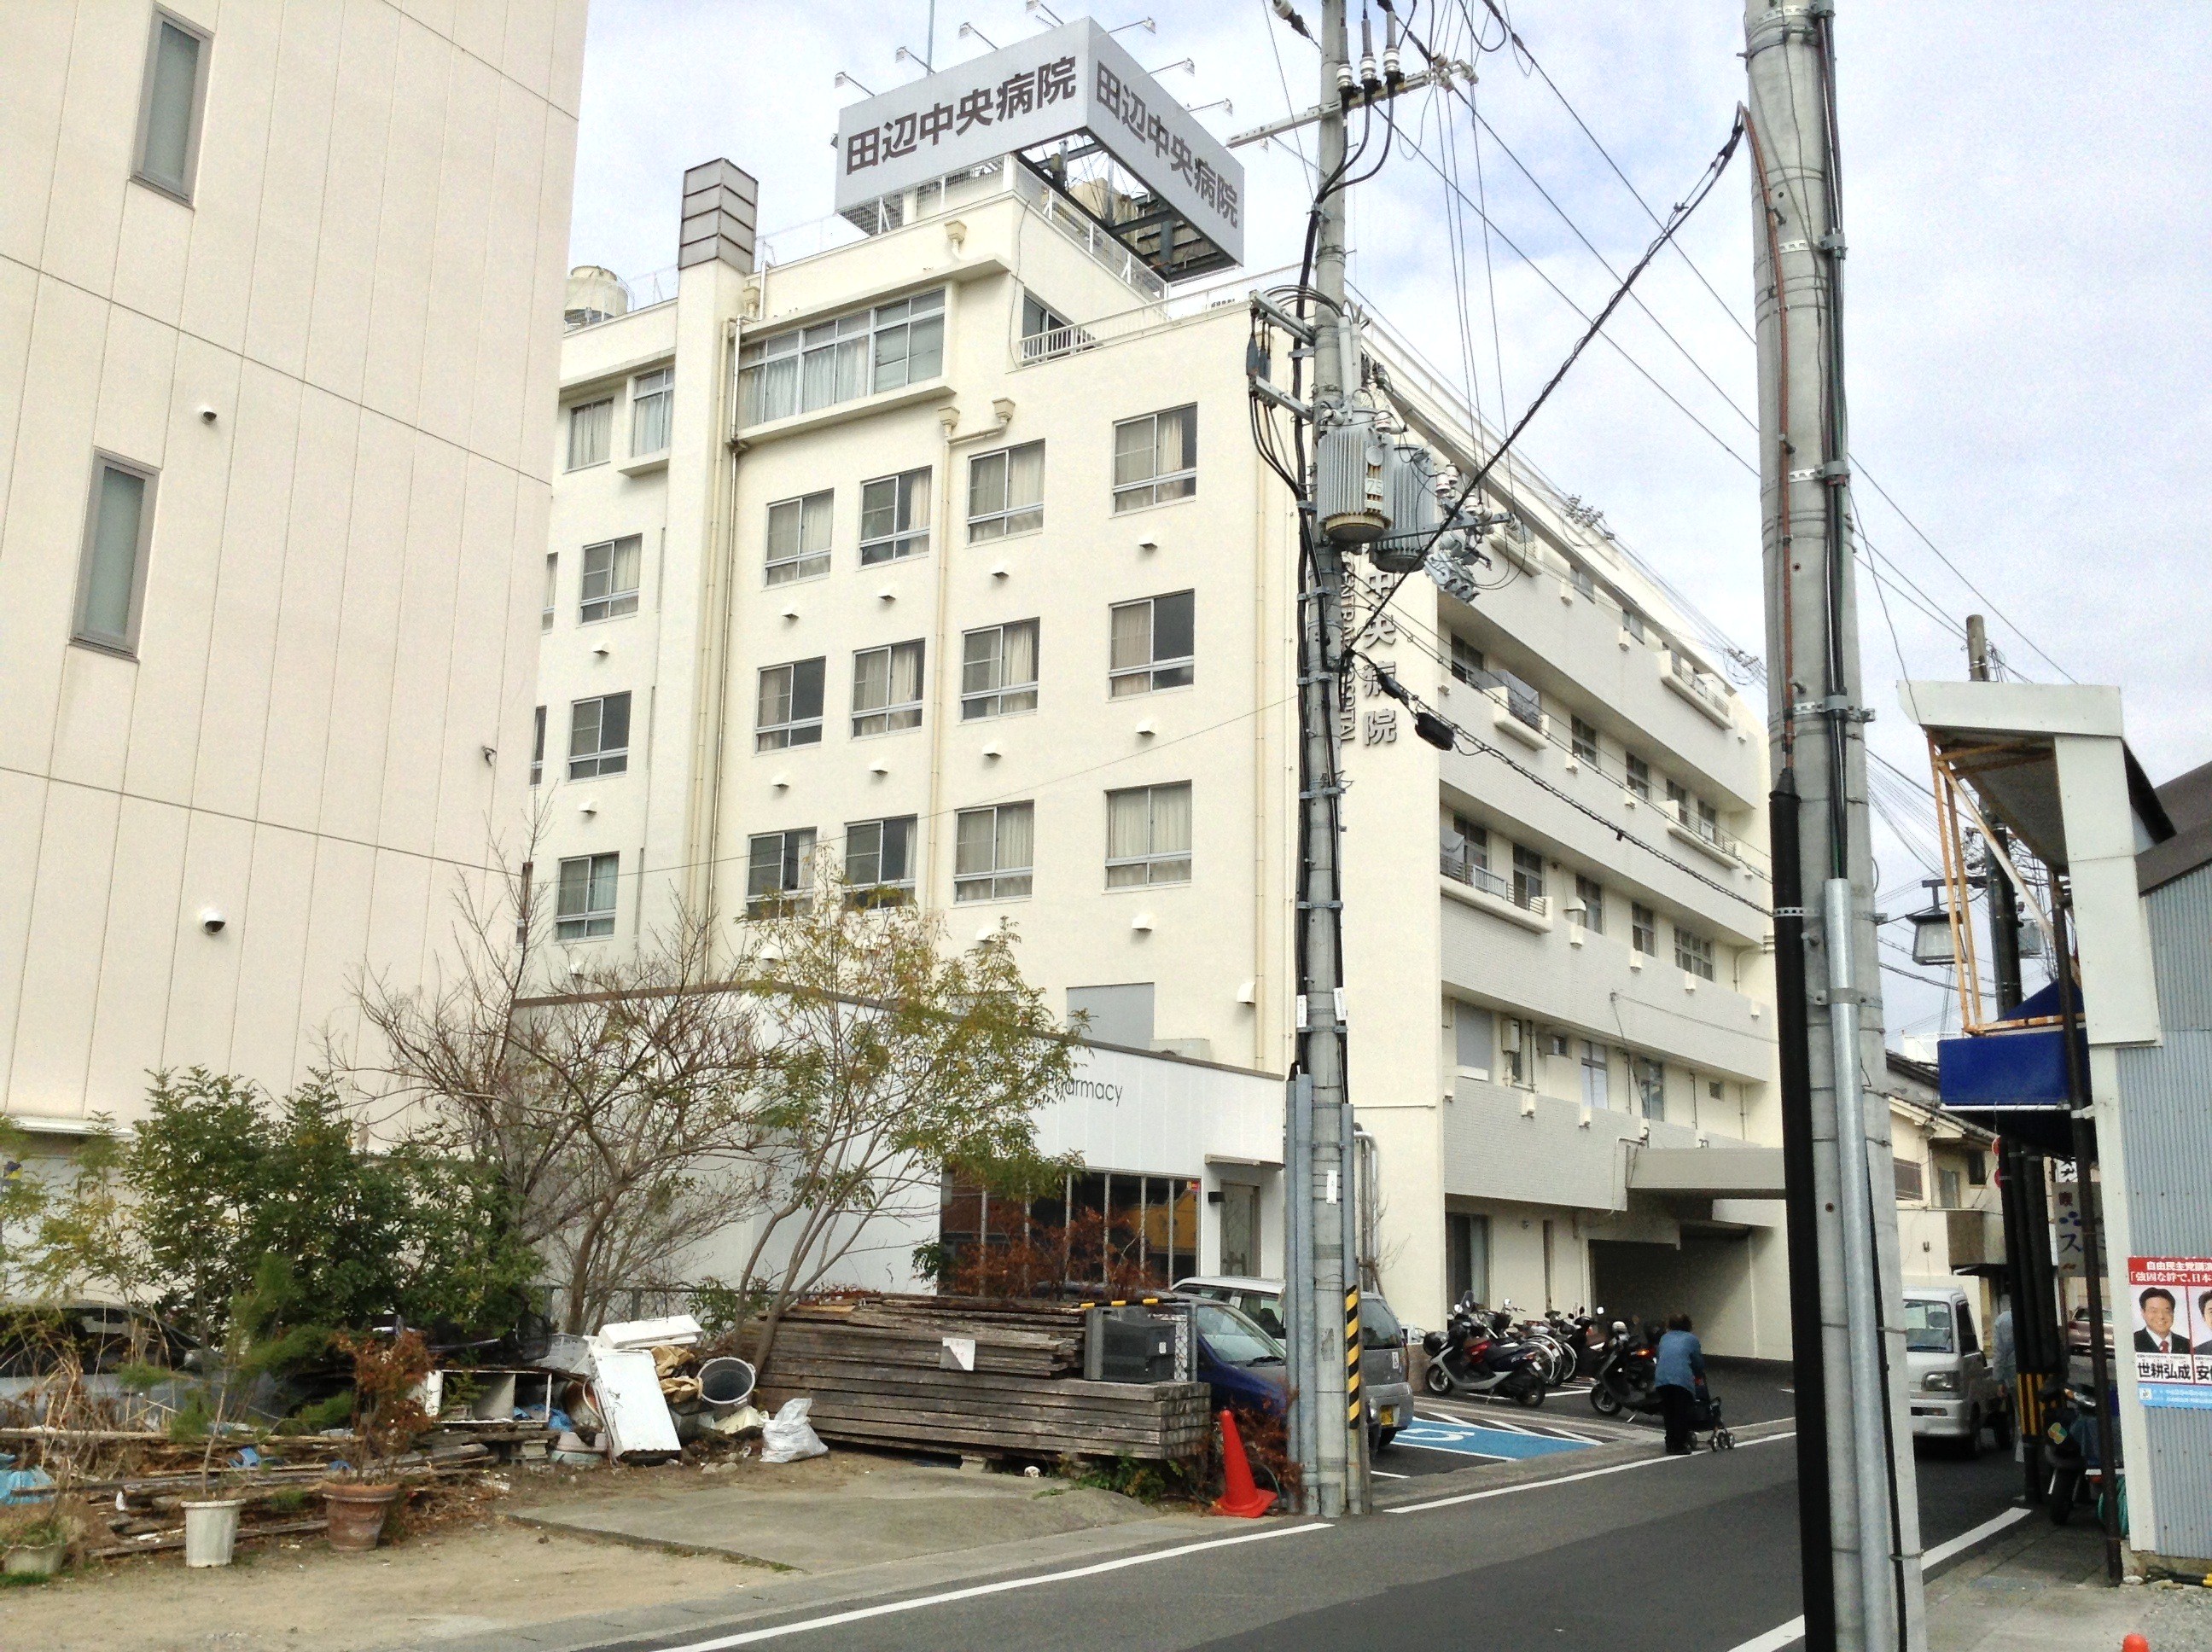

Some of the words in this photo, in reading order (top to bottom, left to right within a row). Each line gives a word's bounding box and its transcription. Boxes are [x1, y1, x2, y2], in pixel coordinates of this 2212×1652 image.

[847, 55, 1077, 176] 田辺中央病院
[1096, 60, 1237, 229] 田辺中央病院
[1366, 480, 1382, 494] 75
[1046, 1076, 1123, 1108] armacy
[2138, 1362, 2191, 1380] 世耕弘成
[2196, 1364, 2212, 1381] 安
